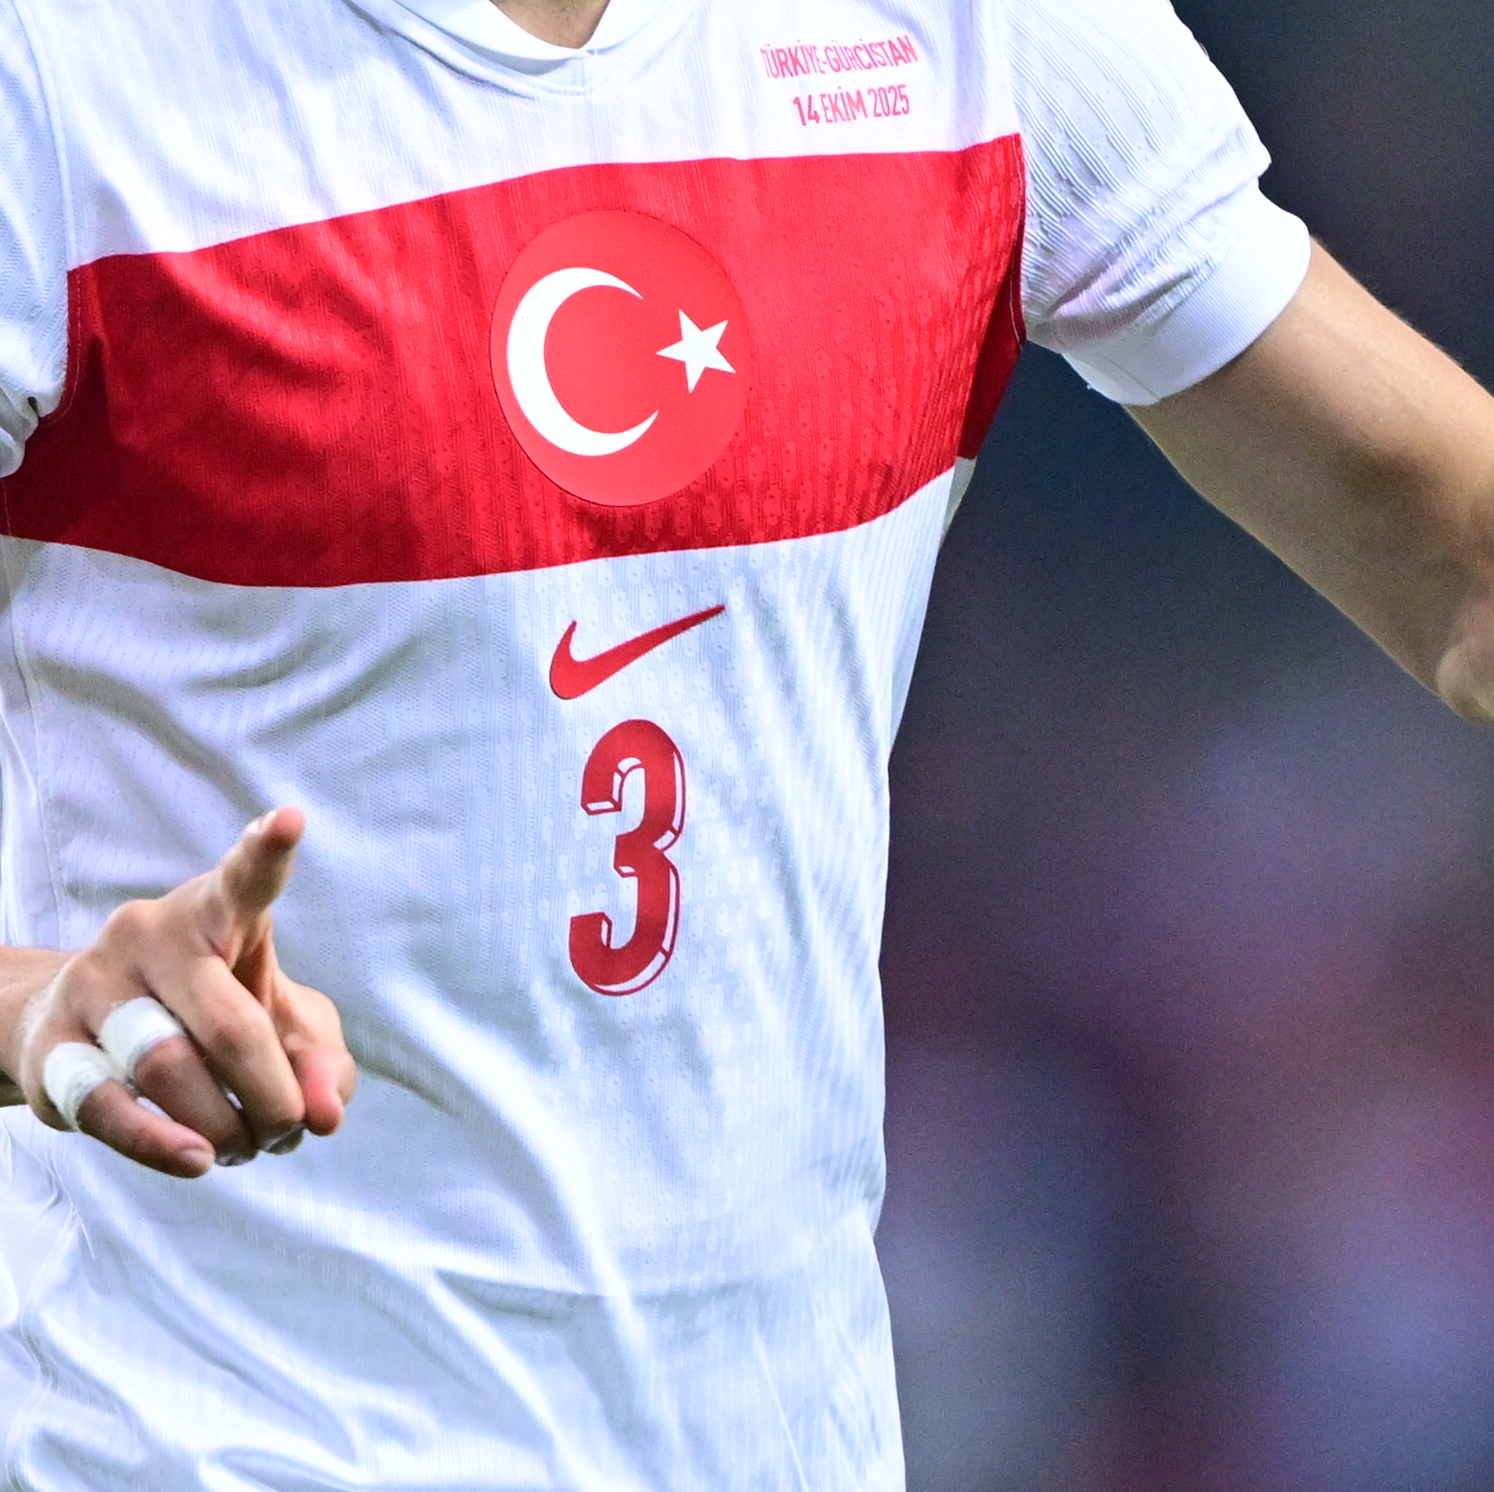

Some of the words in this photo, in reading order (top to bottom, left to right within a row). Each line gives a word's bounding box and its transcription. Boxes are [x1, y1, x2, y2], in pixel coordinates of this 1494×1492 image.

[792, 94, 820, 127] 14
[820, 86, 868, 124] EKİM
[868, 84, 910, 118] 2025
[568, 718, 686, 997] 3
